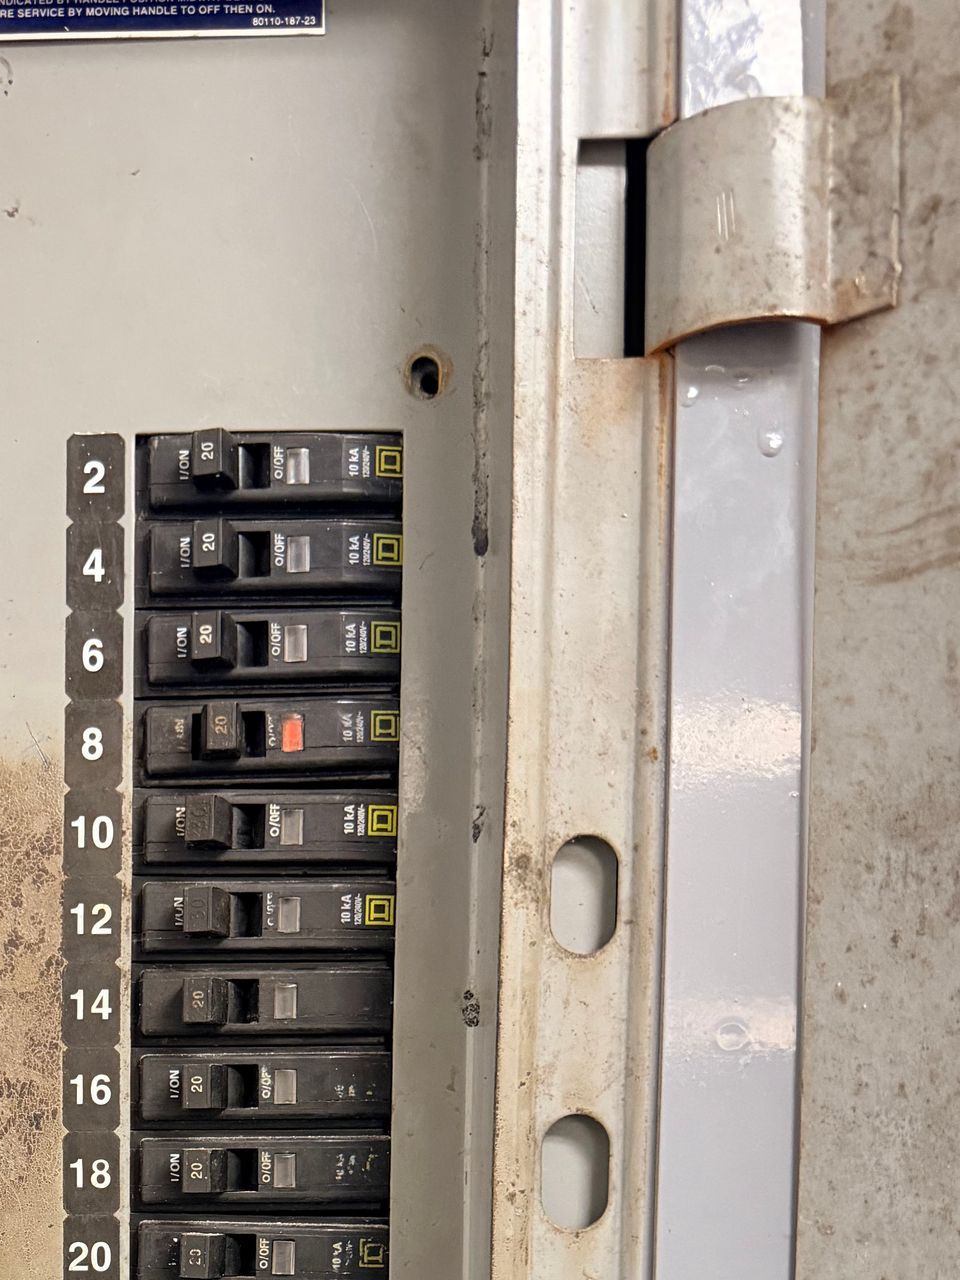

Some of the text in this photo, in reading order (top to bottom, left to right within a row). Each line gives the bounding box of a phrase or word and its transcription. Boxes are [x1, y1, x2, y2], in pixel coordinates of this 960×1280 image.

[18, 9, 65, 18] SERVICE
[68, 8, 82, 17] BY
[85, 7, 130, 17] MOVING
[133, 6, 177, 16] HANDLE
[181, 5, 196, 15] TO
[198, 5, 220, 15] OFF
[223, 4, 253, 14] THEN
[256, 4, 276, 14] ON.
[252, 16, 317, 26] 80110-187-23
[201, 442, 214, 460] 20
[83, 462, 105, 494] 2
[203, 533, 215, 551] 20
[82, 549, 105, 582] 4
[199, 625, 212, 644] 20
[82, 639, 104, 672] 6
[81, 727, 103, 761] 8
[70, 816, 113, 849] 10
[70, 903, 112, 935] 12
[70, 989, 112, 1020] 14
[192, 990, 204, 1008] 20
[70, 1074, 112, 1105] 16
[191, 1076, 203, 1093] 20
[70, 1159, 111, 1188] 18
[191, 1162, 203, 1179] 20
[69, 1241, 112, 1271] 20
